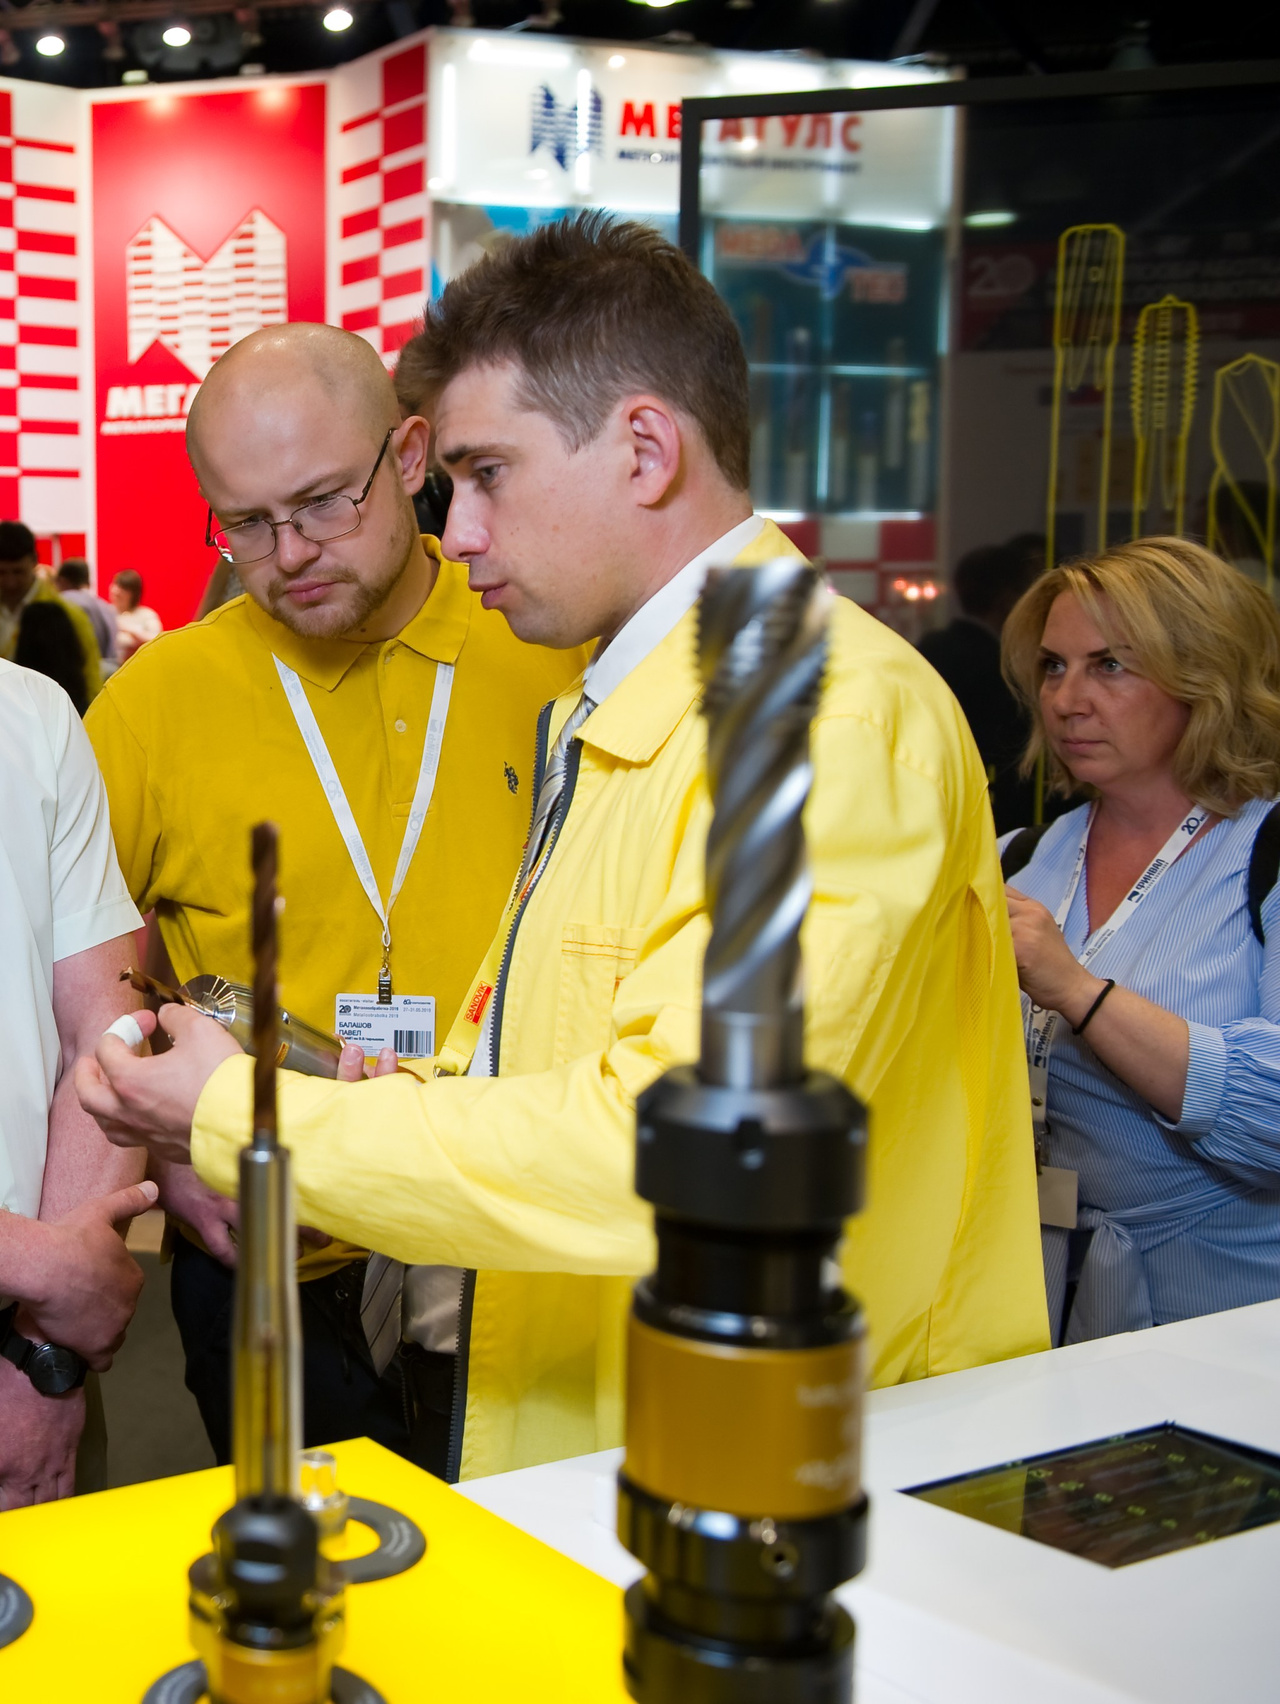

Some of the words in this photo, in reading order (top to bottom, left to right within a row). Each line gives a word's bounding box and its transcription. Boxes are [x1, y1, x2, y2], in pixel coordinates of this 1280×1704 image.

[619, 100, 863, 153] МЕАТУЛС
[1181, 817, 1200, 835] 20
[1135, 858, 1165, 890] ФИНВАЛ
[466, 983, 487, 1021] SANDVIK
